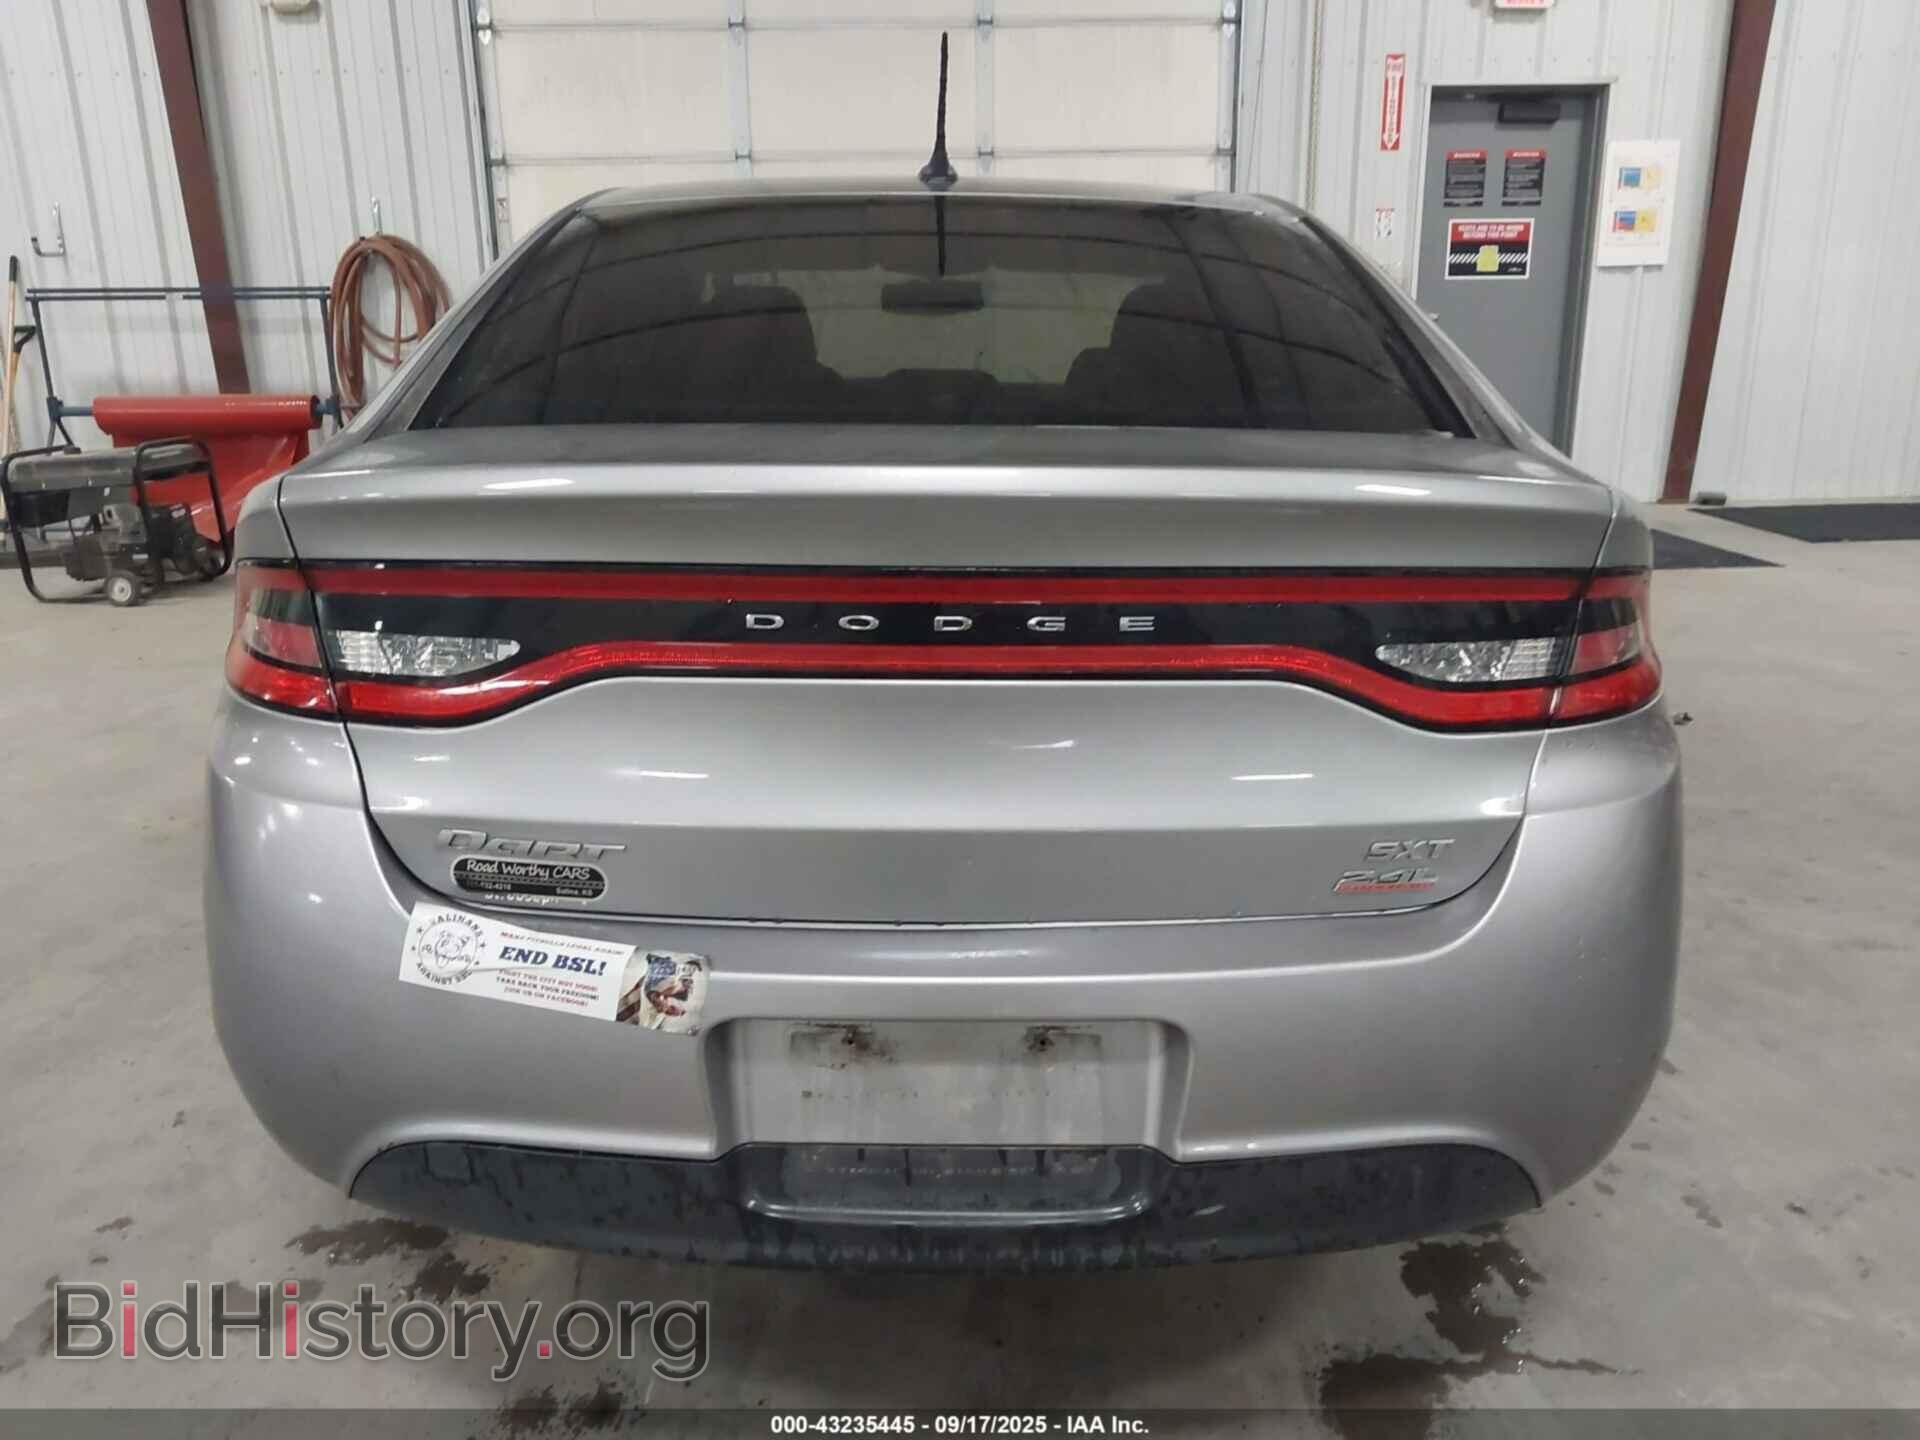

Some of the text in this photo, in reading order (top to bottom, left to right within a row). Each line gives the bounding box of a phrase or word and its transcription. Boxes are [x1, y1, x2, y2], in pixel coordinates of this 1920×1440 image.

[745, 612, 1156, 632] DODGE
[1364, 838, 1456, 862] SXT
[466, 858, 591, 880] Road Worthy CARS
[499, 946, 608, 977] END BSL!
